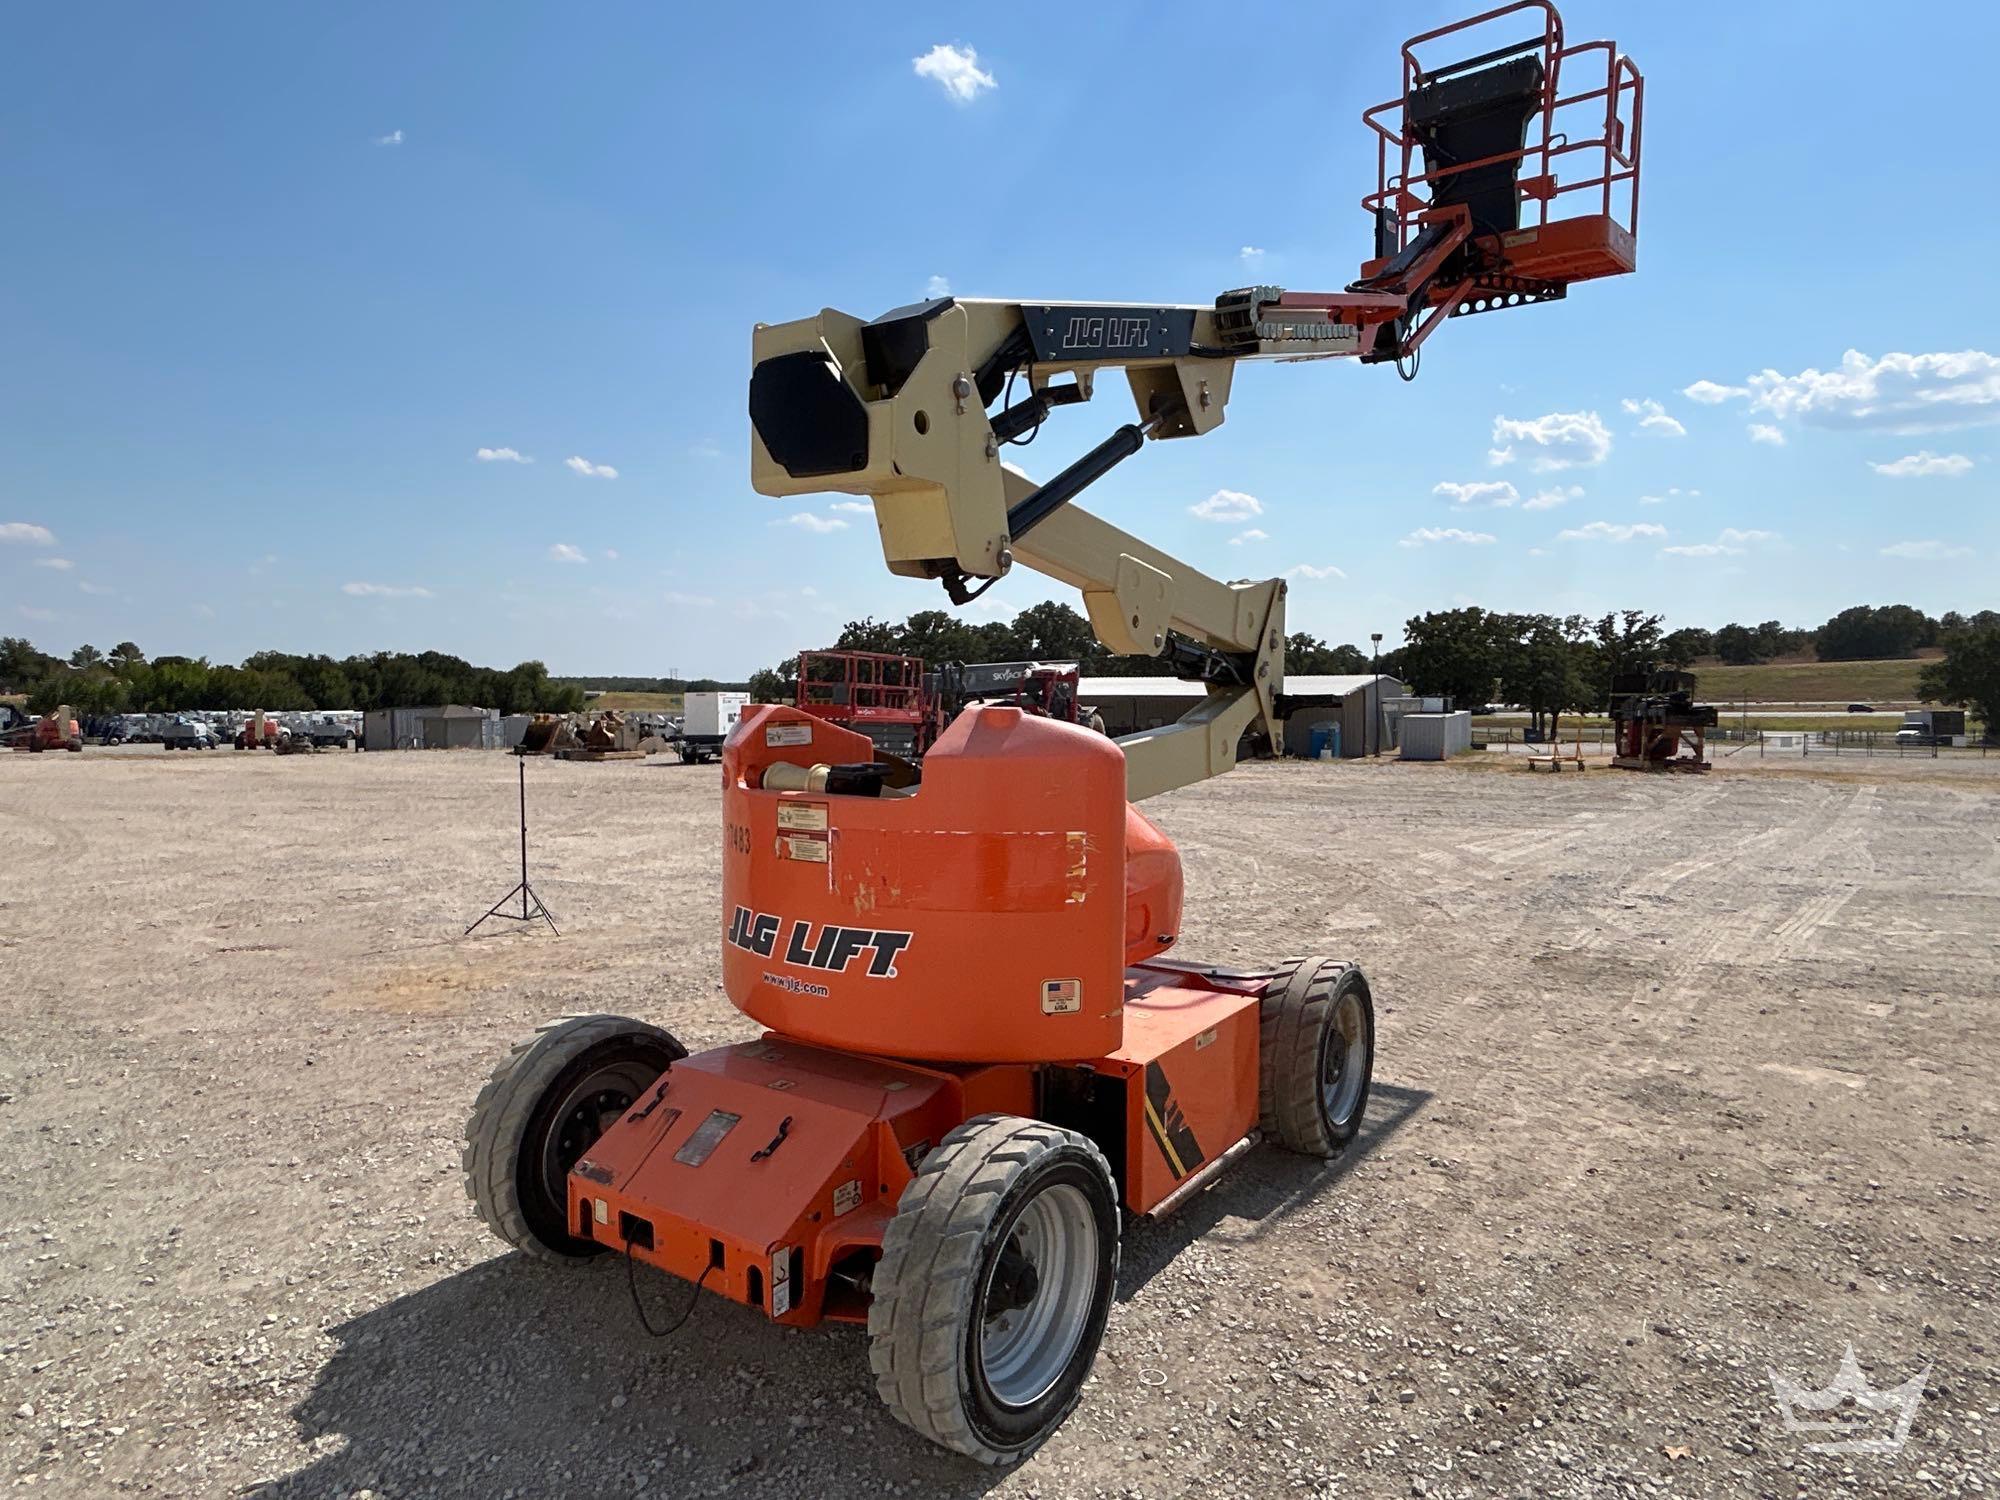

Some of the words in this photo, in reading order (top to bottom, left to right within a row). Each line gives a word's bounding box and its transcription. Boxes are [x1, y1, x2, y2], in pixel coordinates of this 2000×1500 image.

[1063, 317, 1104, 348] JLG
[1107, 317, 1150, 347] LIFT
[728, 904, 782, 959] JLG
[784, 920, 914, 978] LIFT
[763, 971, 829, 998] www.jlg.com
